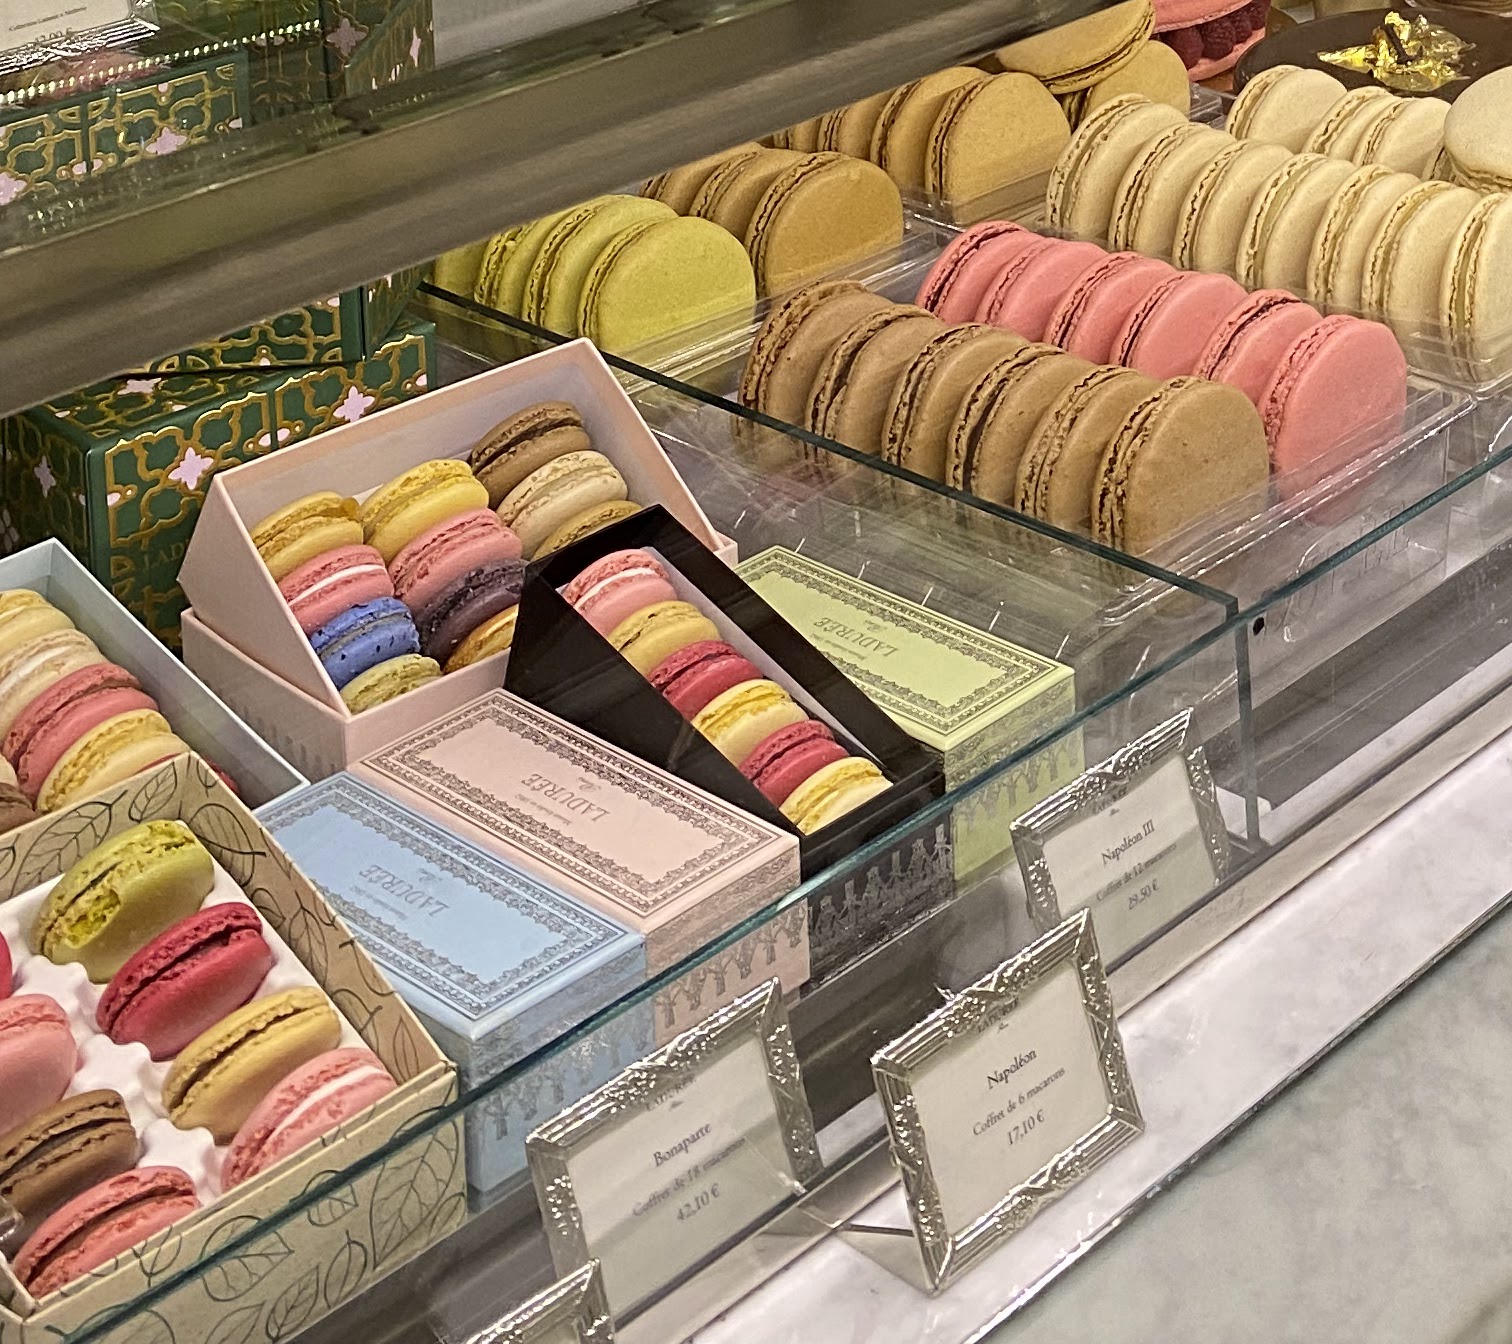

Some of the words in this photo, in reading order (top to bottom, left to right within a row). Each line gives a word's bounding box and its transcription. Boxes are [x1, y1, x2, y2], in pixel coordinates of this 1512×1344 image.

[1101, 831, 1143, 865] Napoléon
[1142, 819, 1155, 837] III
[987, 1049, 1037, 1090] Napoléon
[973, 1108, 1005, 1136] Coffret
[1006, 1099, 1017, 1113] de
[1018, 1093, 1025, 1105] 6
[1026, 1067, 1066, 1100] macarons
[653, 1123, 712, 1167] Bonaparte
[1007, 1115, 1036, 1145] 17,10
[632, 1187, 670, 1217] Coffret
[673, 1177, 686, 1192] de
[687, 1165, 701, 1183] 18
[676, 1190, 710, 1221] 42,10
